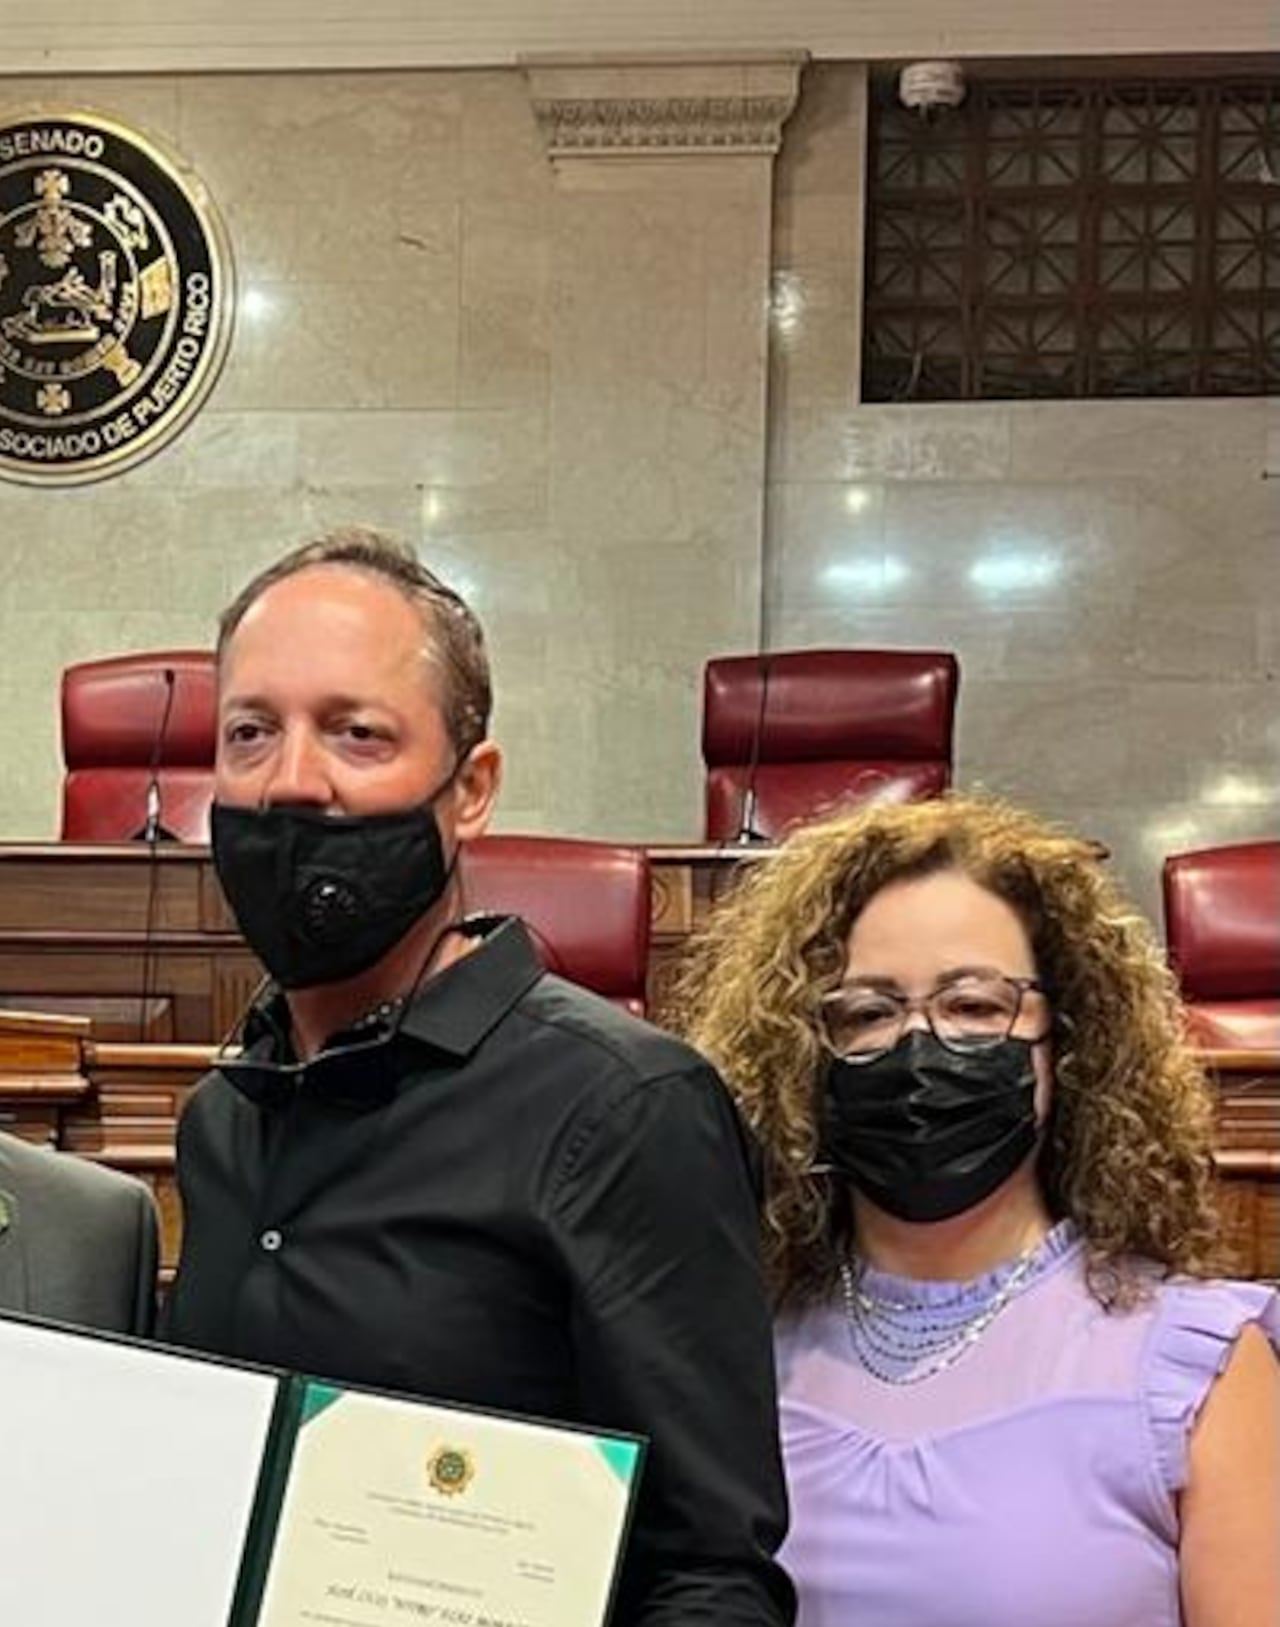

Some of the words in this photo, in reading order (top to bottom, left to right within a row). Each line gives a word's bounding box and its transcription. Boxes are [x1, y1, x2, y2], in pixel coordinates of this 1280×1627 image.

[100, 412, 138, 445] DE
[132, 336, 200, 425] PUERTO
[183, 272, 210, 336] RICO
